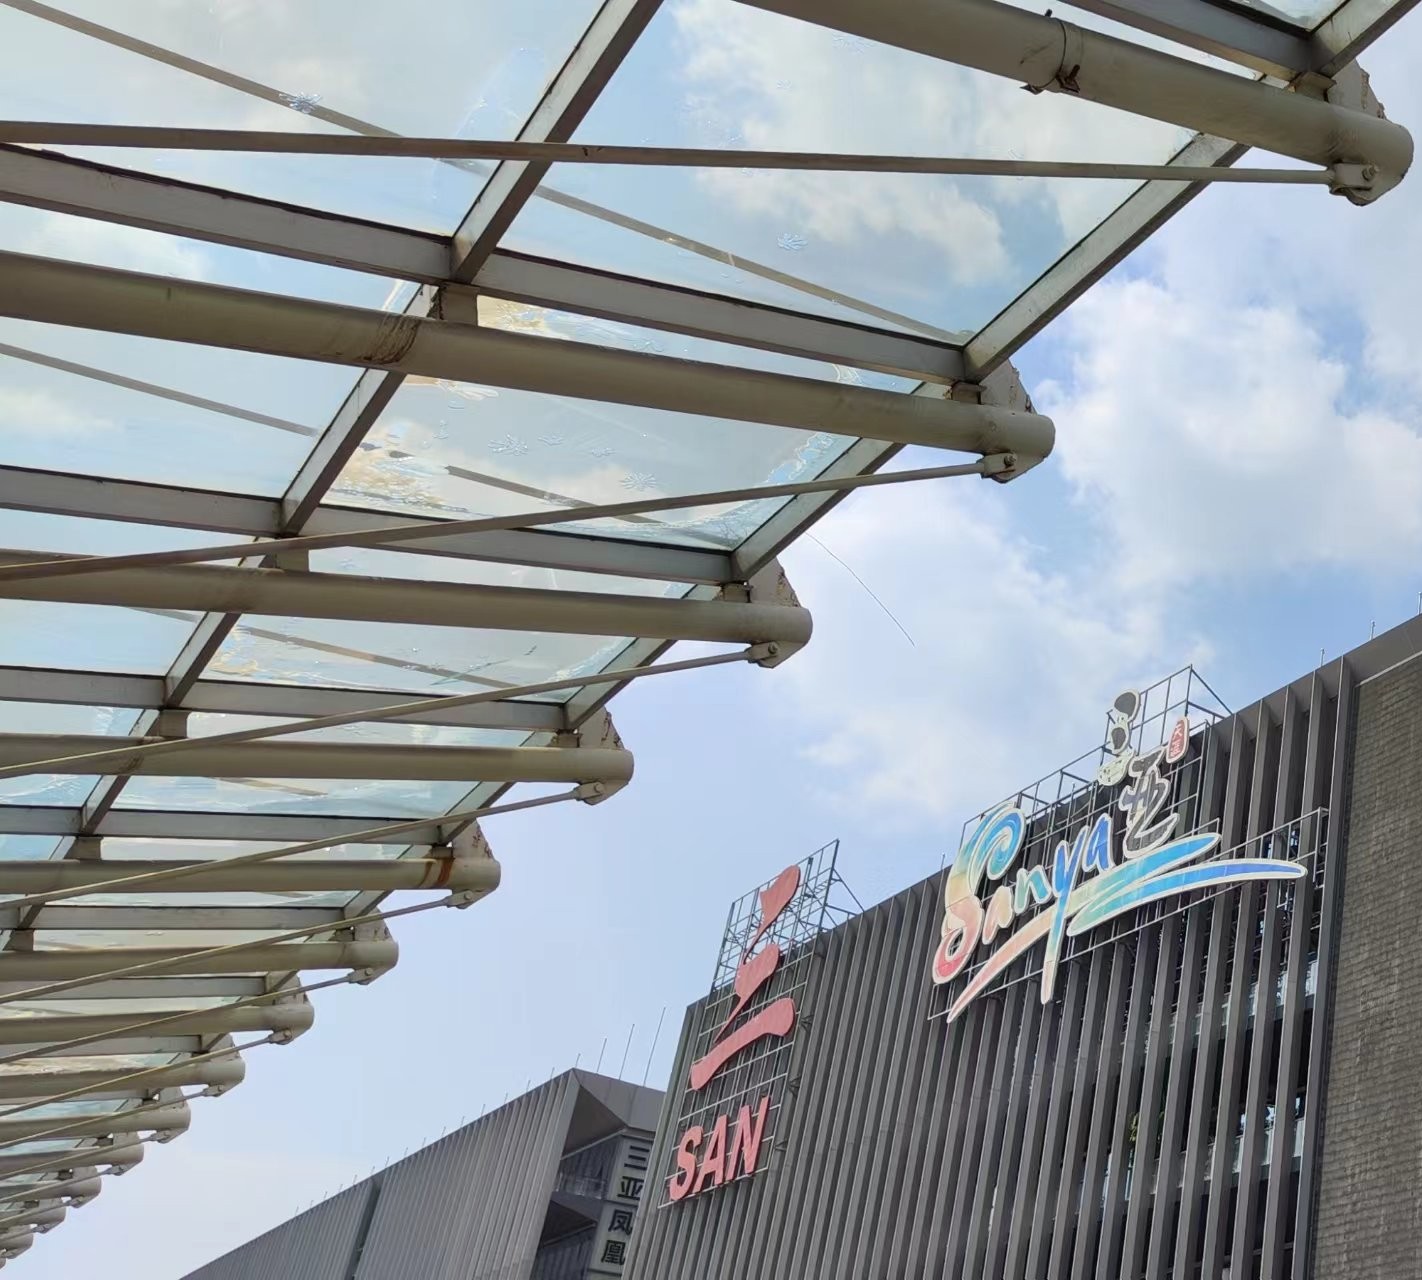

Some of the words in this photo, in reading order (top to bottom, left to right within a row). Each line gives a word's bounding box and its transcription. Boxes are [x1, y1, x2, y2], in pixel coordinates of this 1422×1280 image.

[690, 864, 801, 1091] 三
[932, 802, 1116, 1005] Sanya
[600, 1144, 651, 1266] 三亚凤凰
[669, 1095, 770, 1202] SAN
